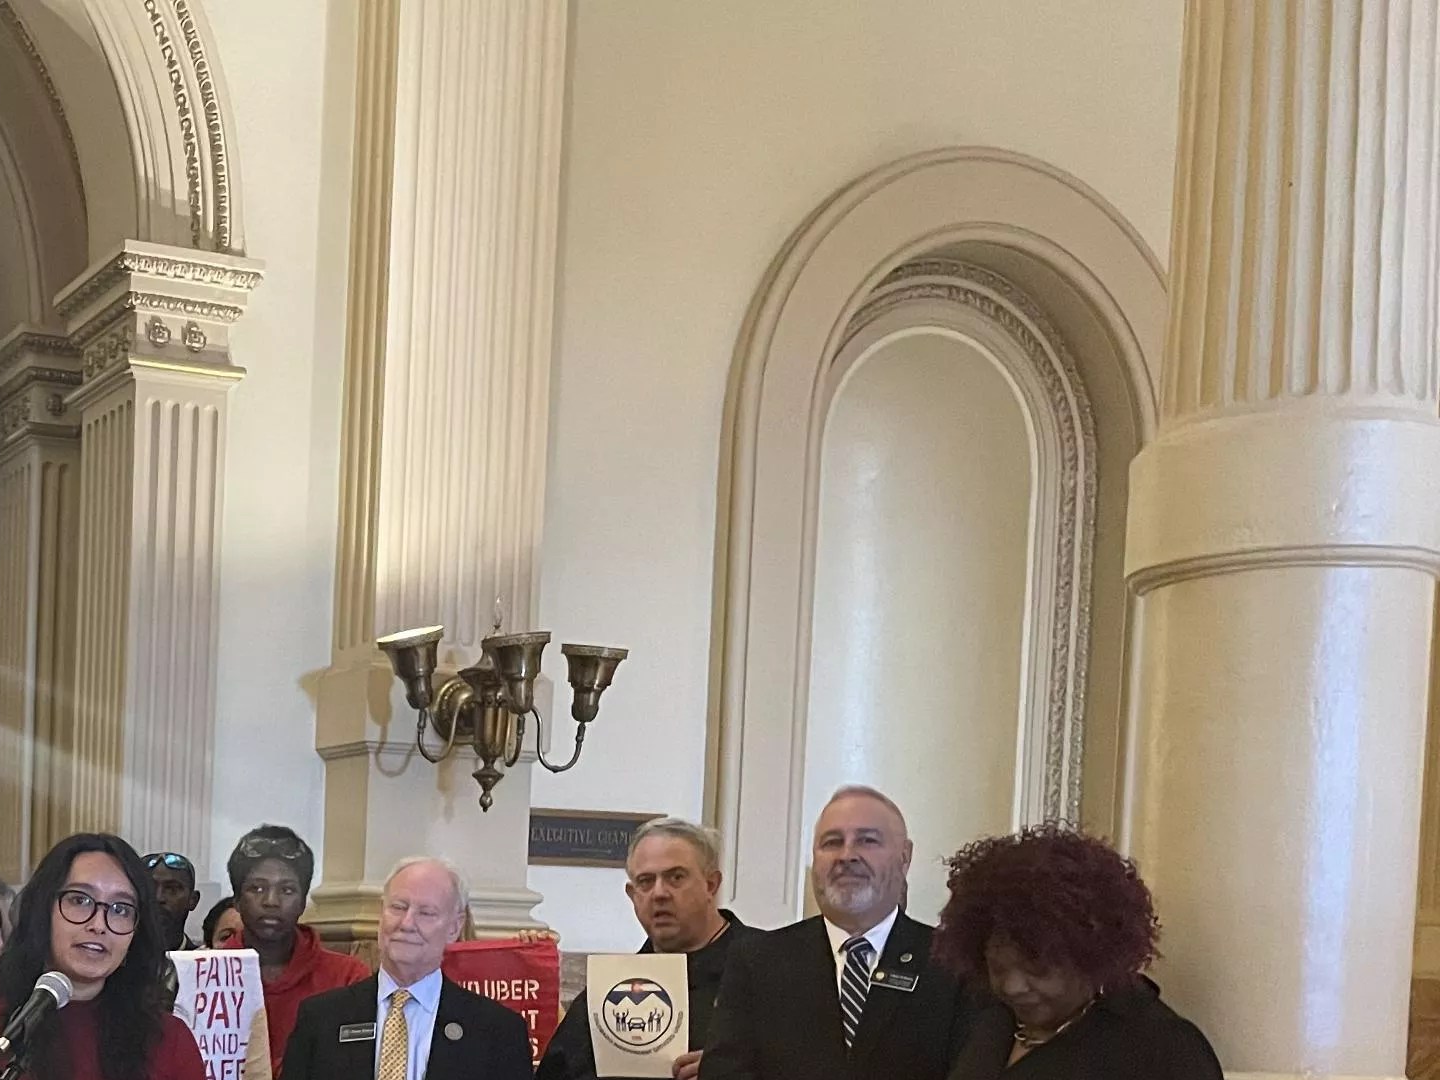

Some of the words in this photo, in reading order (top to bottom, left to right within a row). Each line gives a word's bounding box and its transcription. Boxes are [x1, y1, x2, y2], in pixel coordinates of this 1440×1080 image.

[531, 826, 592, 846] EXECUTIVE
[193, 956, 245, 989] FAIR
[484, 979, 540, 1000] UBER
[192, 991, 246, 1030] PAY
